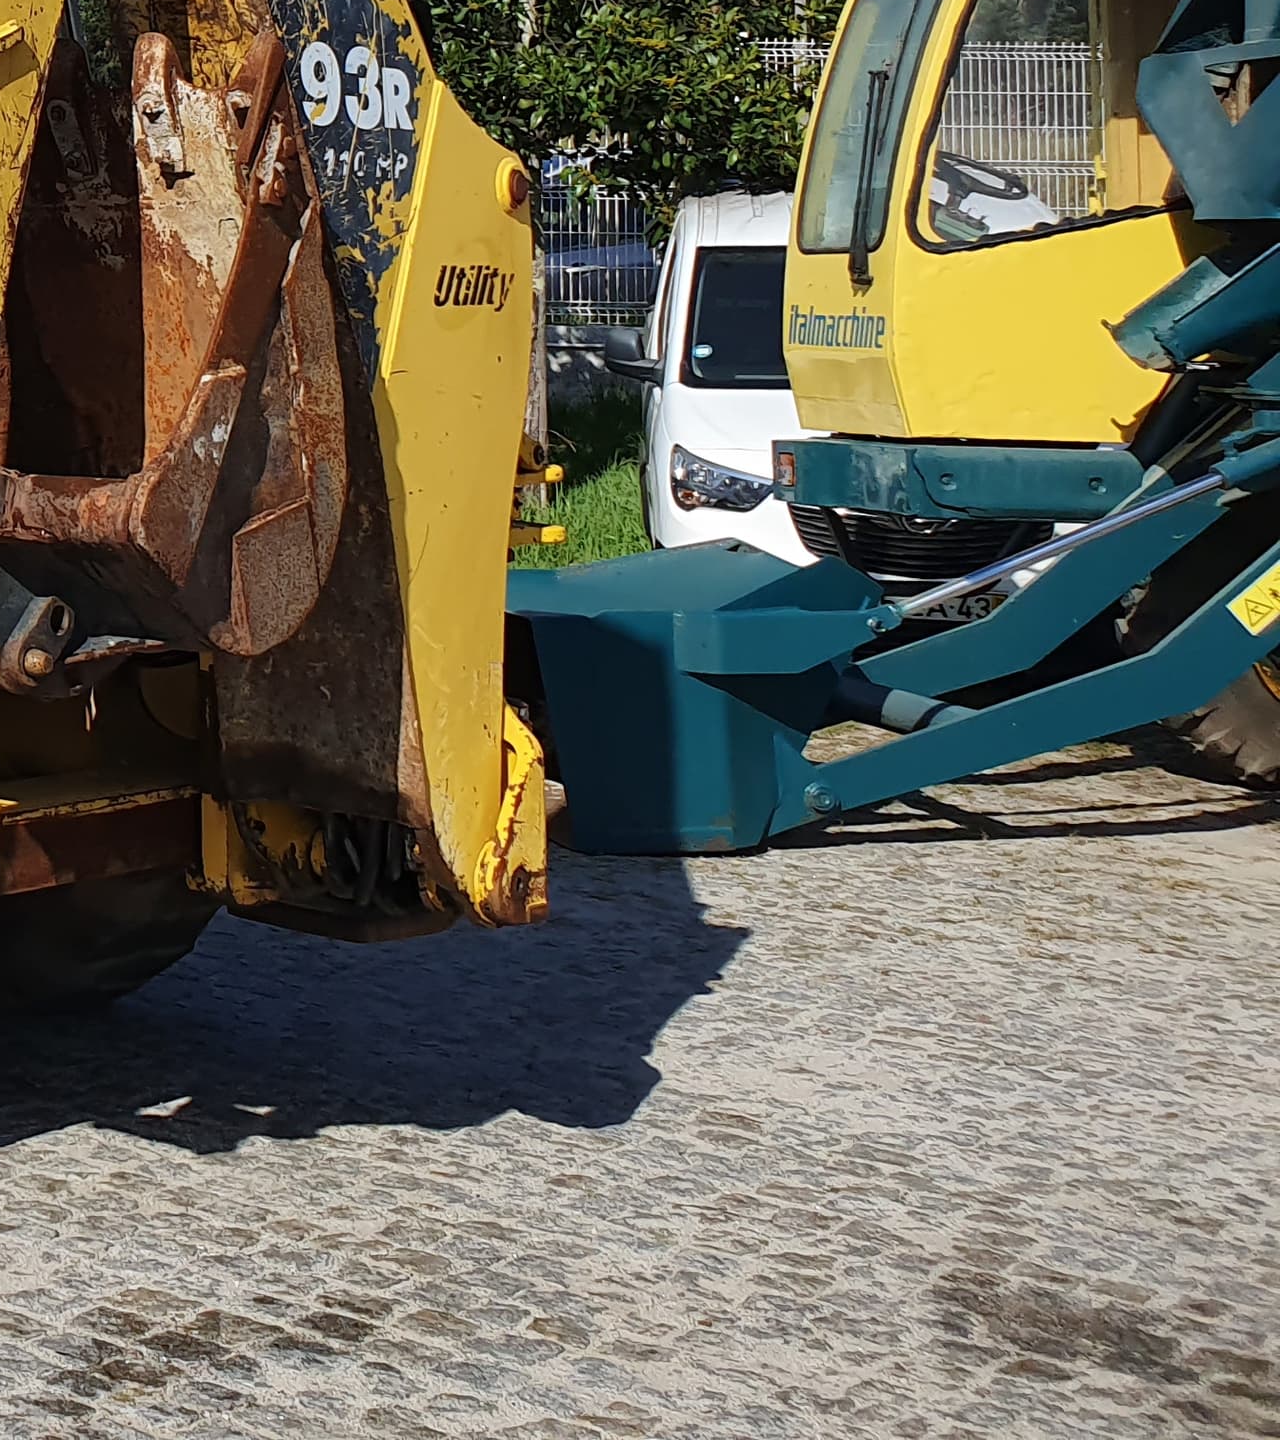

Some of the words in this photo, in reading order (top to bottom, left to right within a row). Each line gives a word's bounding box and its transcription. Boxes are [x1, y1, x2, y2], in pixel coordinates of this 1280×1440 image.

[300, 41, 414, 131] 93R
[434, 264, 515, 313] Utility
[788, 304, 885, 349] italmacchine
